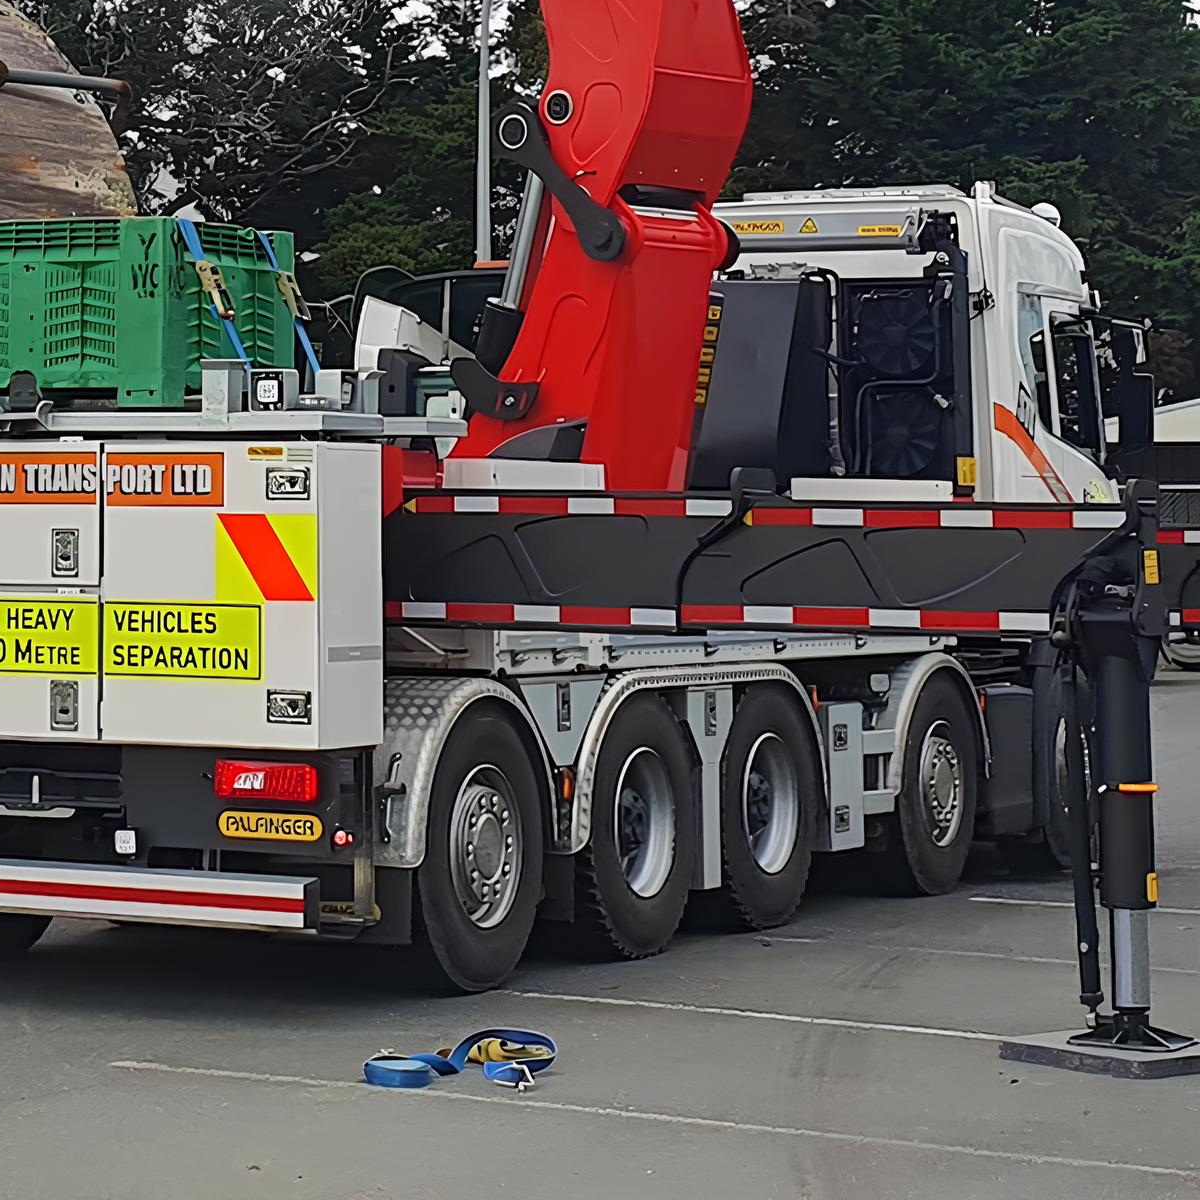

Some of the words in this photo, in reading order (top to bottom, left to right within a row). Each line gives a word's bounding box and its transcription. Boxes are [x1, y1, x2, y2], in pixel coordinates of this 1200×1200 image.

[23, 464, 166, 495] TRANSPORT
[172, 464, 212, 495] LTD
[7, 608, 74, 631] HEAVY
[113, 610, 217, 633] VEHICLES
[112, 644, 249, 670] SEPARATION
[226, 815, 315, 836] PALFINGER
